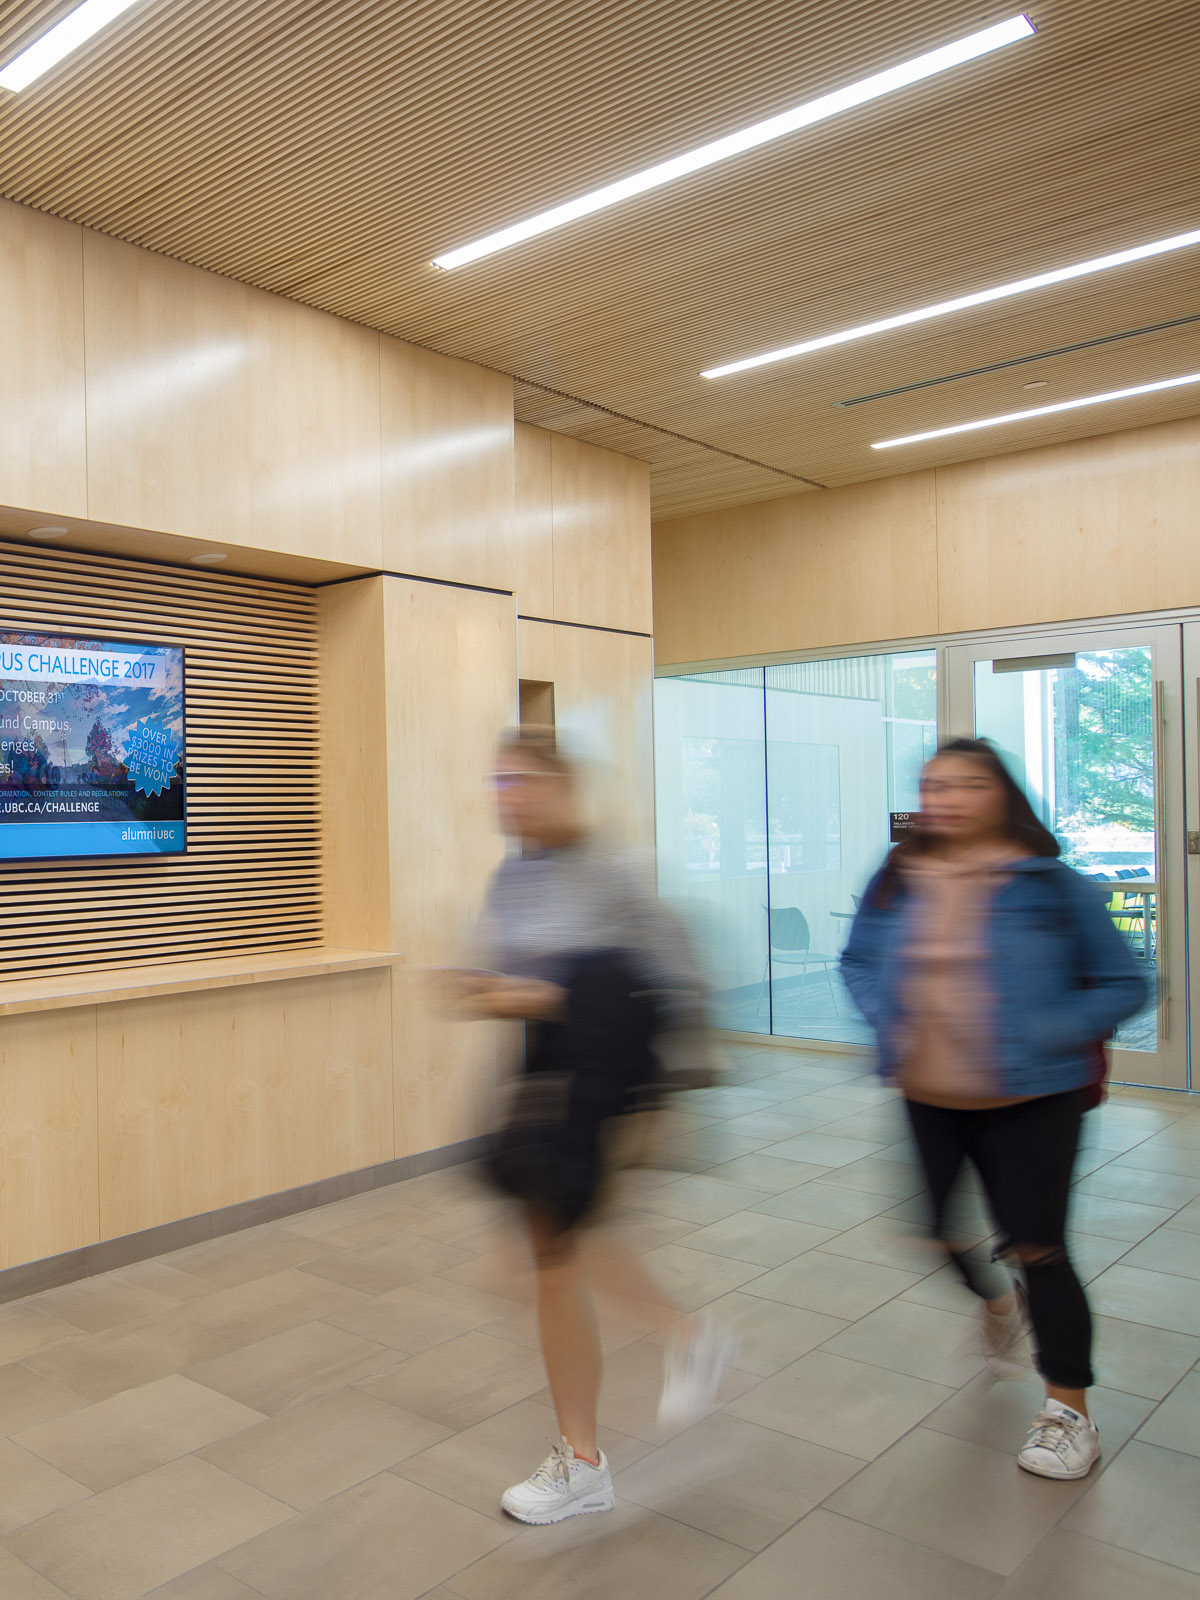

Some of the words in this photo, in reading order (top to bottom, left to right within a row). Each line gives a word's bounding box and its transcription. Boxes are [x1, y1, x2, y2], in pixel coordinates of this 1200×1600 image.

[28, 653, 120, 678] CHALLENGE
[123, 660, 156, 680] 2017
[23, 715, 72, 733] Campus,
[142, 727, 167, 745] OVER
[127, 747, 158, 768] PRIZES
[161, 758, 174, 773] TO
[131, 736, 161, 756] $3000
[163, 747, 174, 761] IN
[130, 760, 141, 775] BE
[144, 765, 168, 783] WON
[33, 790, 59, 798] CONTEST
[60, 790, 77, 798] RULES
[78, 790, 91, 798] AND
